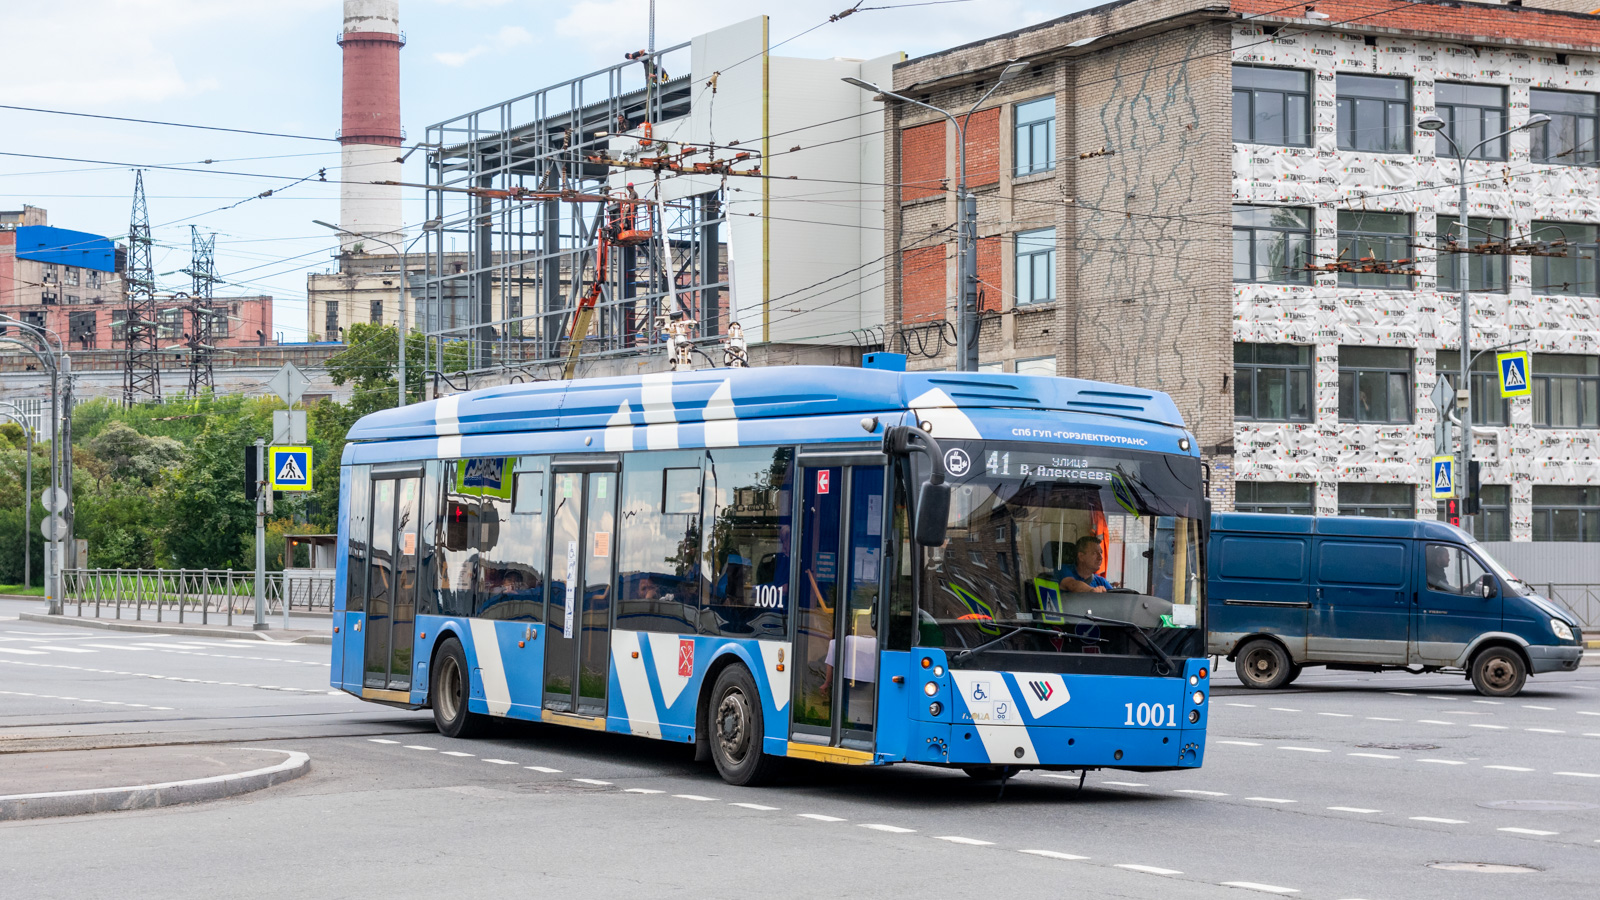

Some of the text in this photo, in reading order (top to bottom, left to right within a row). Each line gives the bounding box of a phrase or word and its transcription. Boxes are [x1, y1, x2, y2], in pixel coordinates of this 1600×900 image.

[1012, 428, 1148, 446] СПб ГУП «ГОРЭЛЕКТРОТРАНС»
[986, 450, 1010, 476] 41
[1020, 464, 1113, 481] В. Алексеева
[754, 585, 784, 608] 1001
[1124, 702, 1176, 727] 1001
